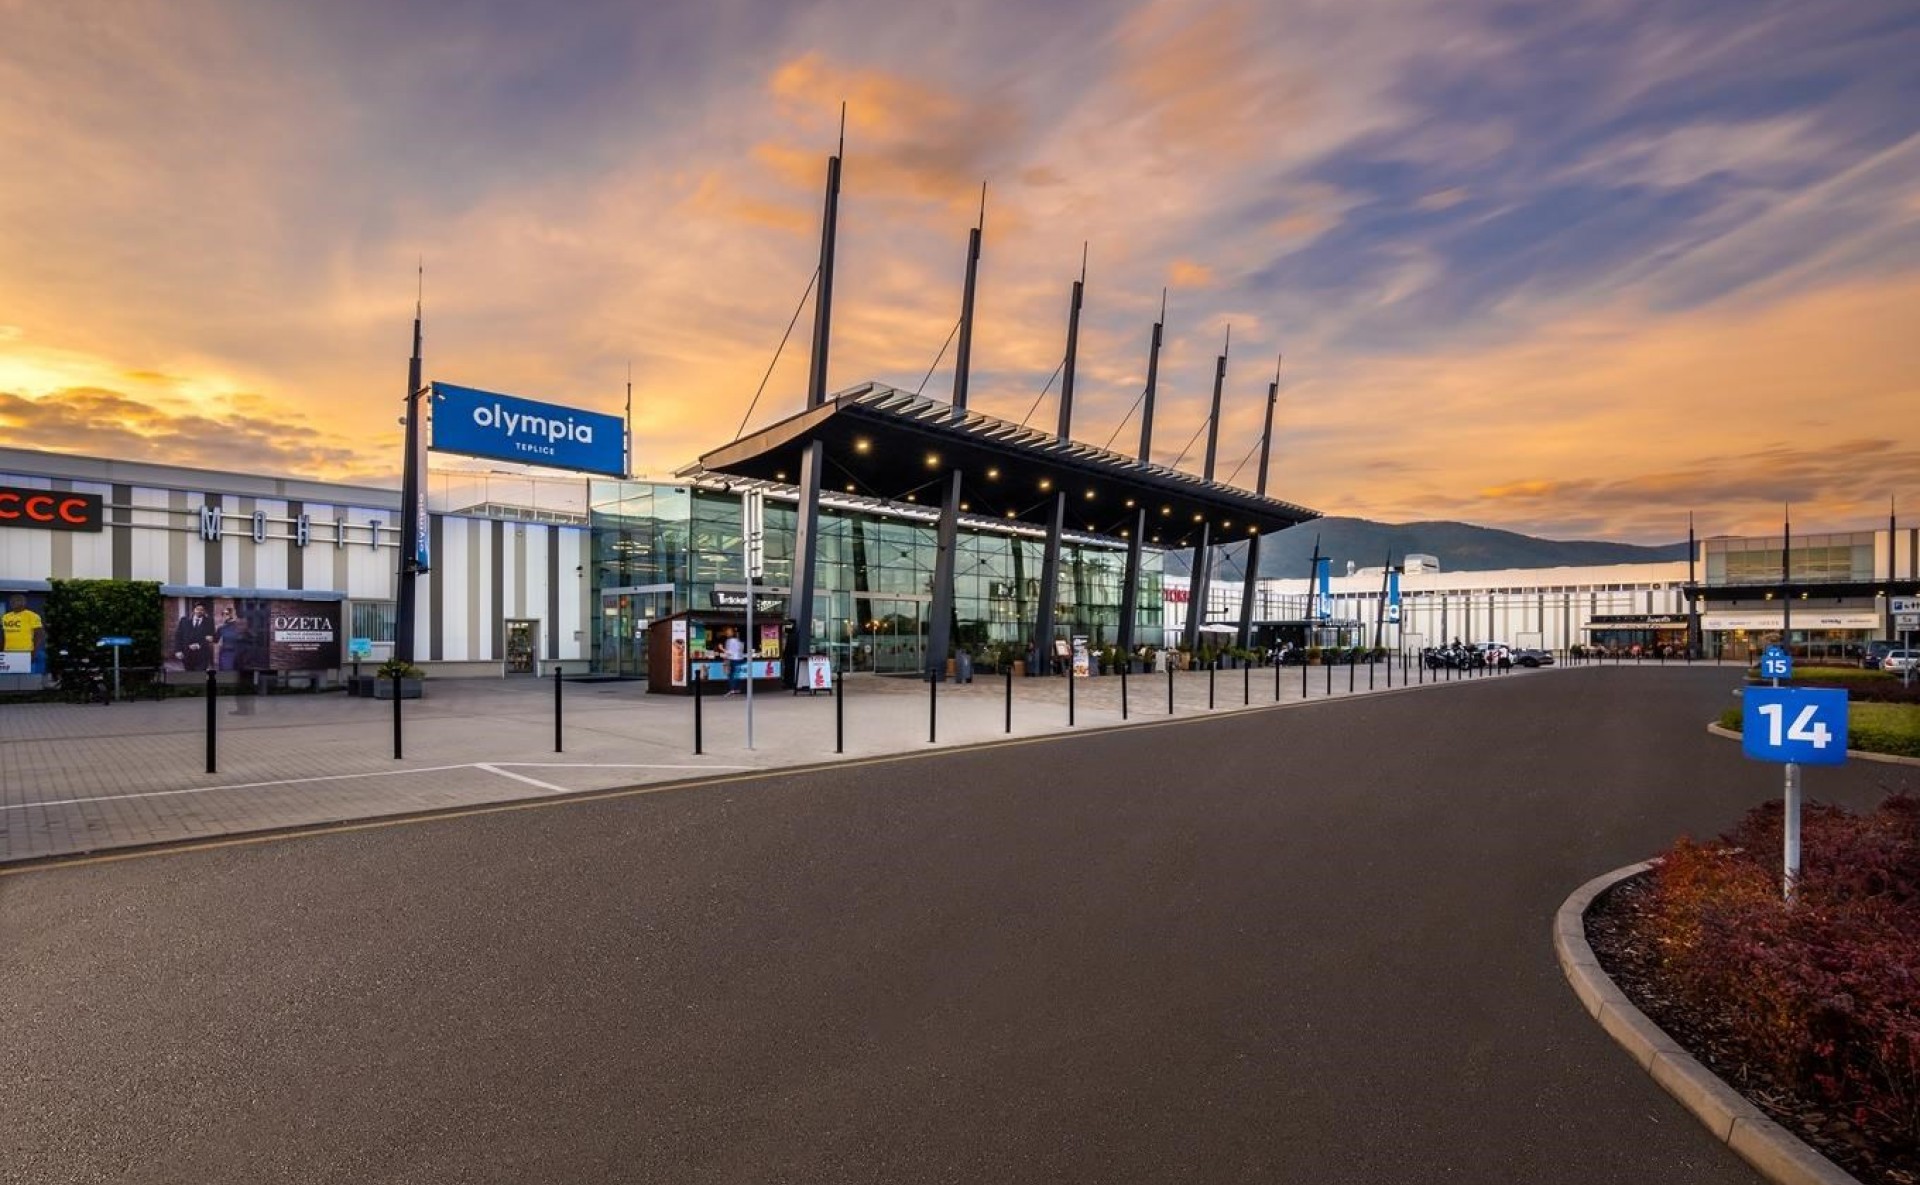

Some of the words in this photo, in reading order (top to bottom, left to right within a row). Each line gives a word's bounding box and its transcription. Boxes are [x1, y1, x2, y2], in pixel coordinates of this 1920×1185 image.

[473, 403, 593, 444] olympia
[515, 442, 555, 456] TEPLICE
[0, 493, 89, 523] CCC
[274, 616, 333, 630] OZETA
[1765, 659, 1787, 674] 15
[1758, 703, 1832, 749] 14
